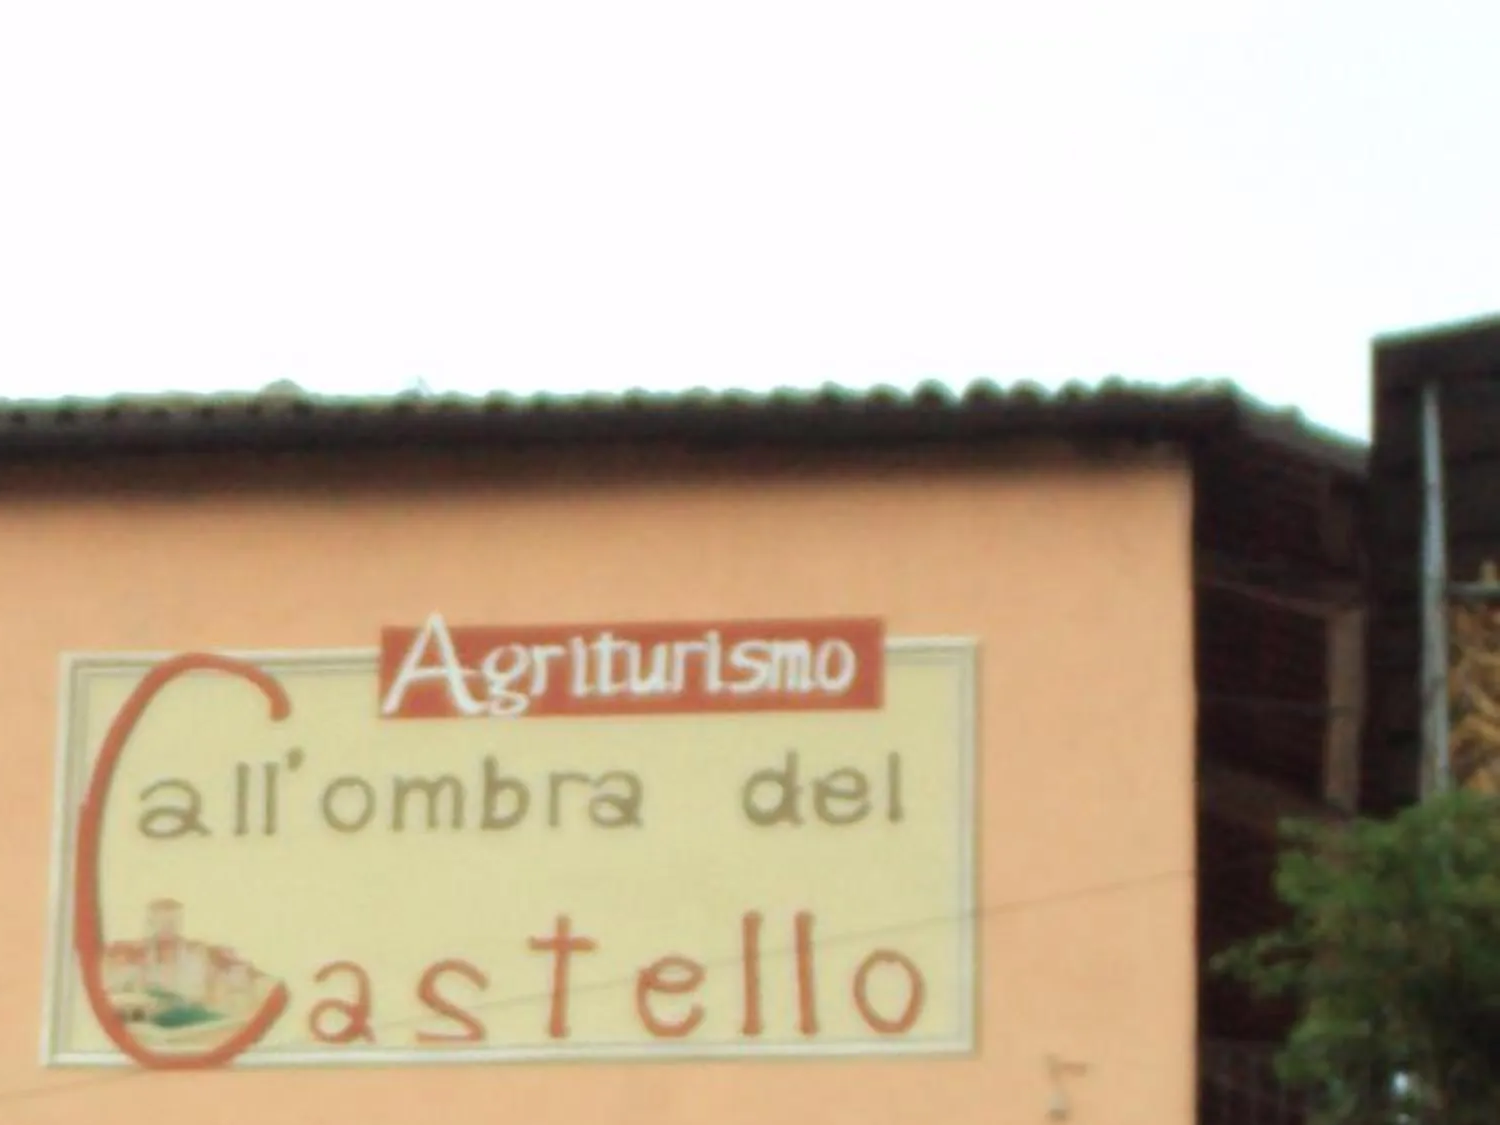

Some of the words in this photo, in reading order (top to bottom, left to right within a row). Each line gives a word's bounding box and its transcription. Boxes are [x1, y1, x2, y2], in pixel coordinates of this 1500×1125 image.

[382, 612, 856, 717] Agriturismo
[137, 748, 644, 839] all'ombra
[740, 750, 906, 828] del
